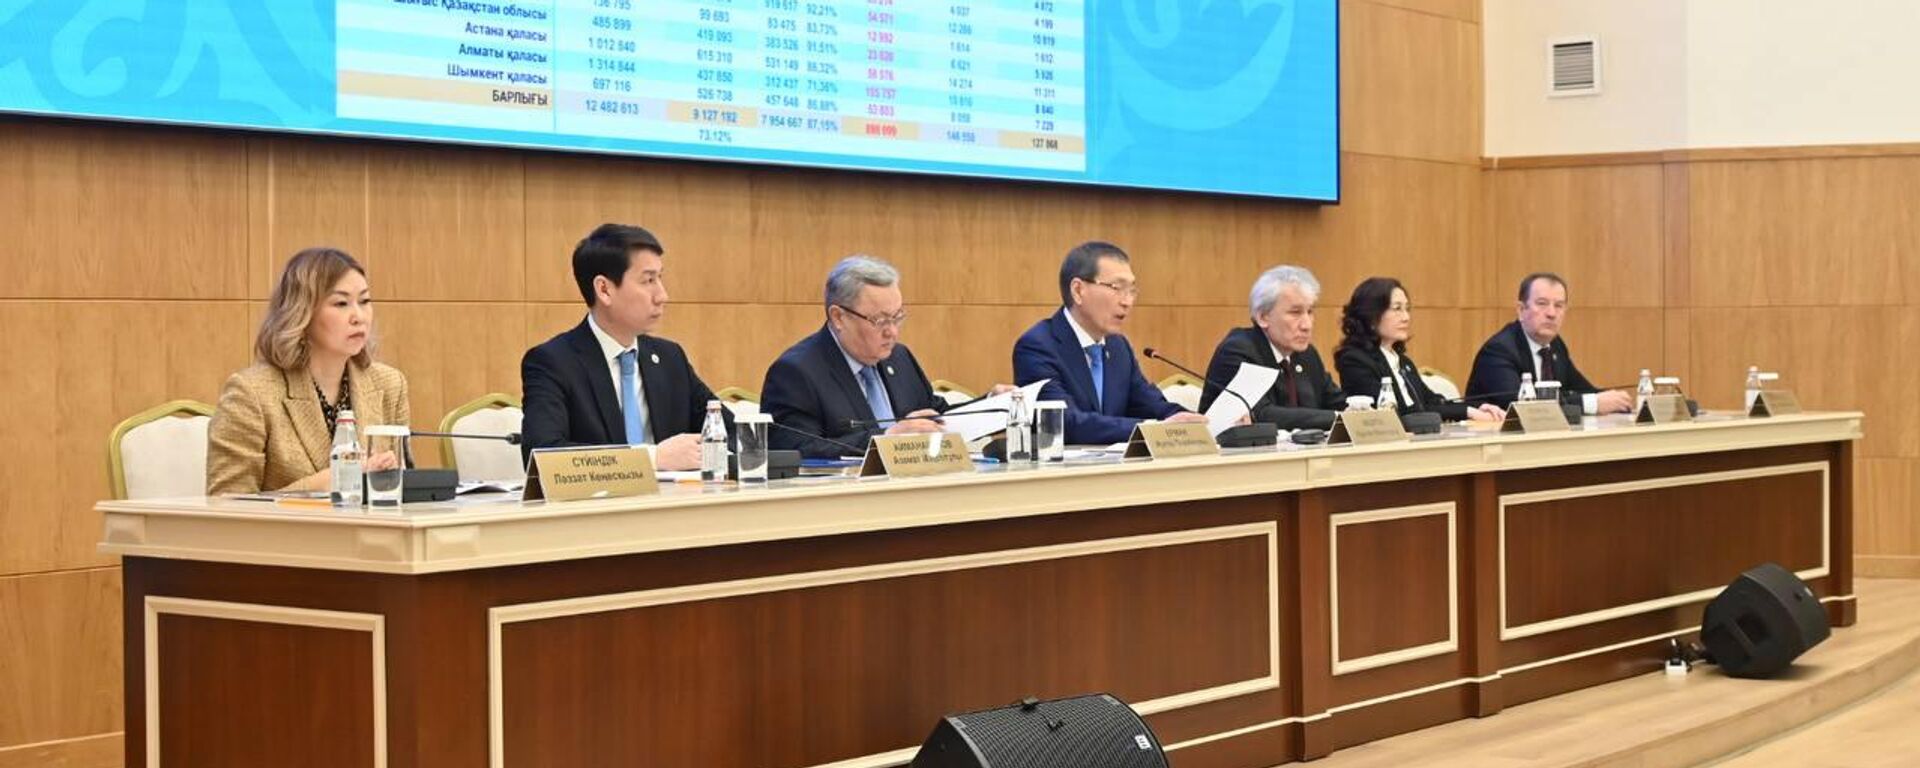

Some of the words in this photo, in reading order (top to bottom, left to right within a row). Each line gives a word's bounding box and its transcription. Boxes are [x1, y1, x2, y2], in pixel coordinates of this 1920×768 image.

[441, 0, 500, 14] Қазақстан
[502, 4, 547, 19] облысы
[592, 16, 611, 28] 485
[613, 18, 632, 30] 899
[780, 19, 796, 31] 475
[465, 21, 504, 37] Астана
[507, 29, 547, 42] қаласы
[697, 29, 714, 41] 419
[597, 38, 615, 50] 012
[458, 43, 504, 58] Алматы
[507, 50, 547, 63] қаласы
[597, 59, 615, 70] 314
[766, 56, 780, 68] 531
[447, 63, 505, 80] Шымкент
[507, 72, 547, 84] қаласы
[697, 69, 714, 80] 437
[593, 77, 610, 90] 697
[614, 80, 632, 92] 116
[492, 89, 548, 105] БАРЛЫҒЫ
[586, 100, 598, 111] 12
[600, 100, 618, 113] 482
[620, 102, 639, 115] 613
[702, 109, 718, 121] 127
[699, 128, 732, 142] 73,12%
